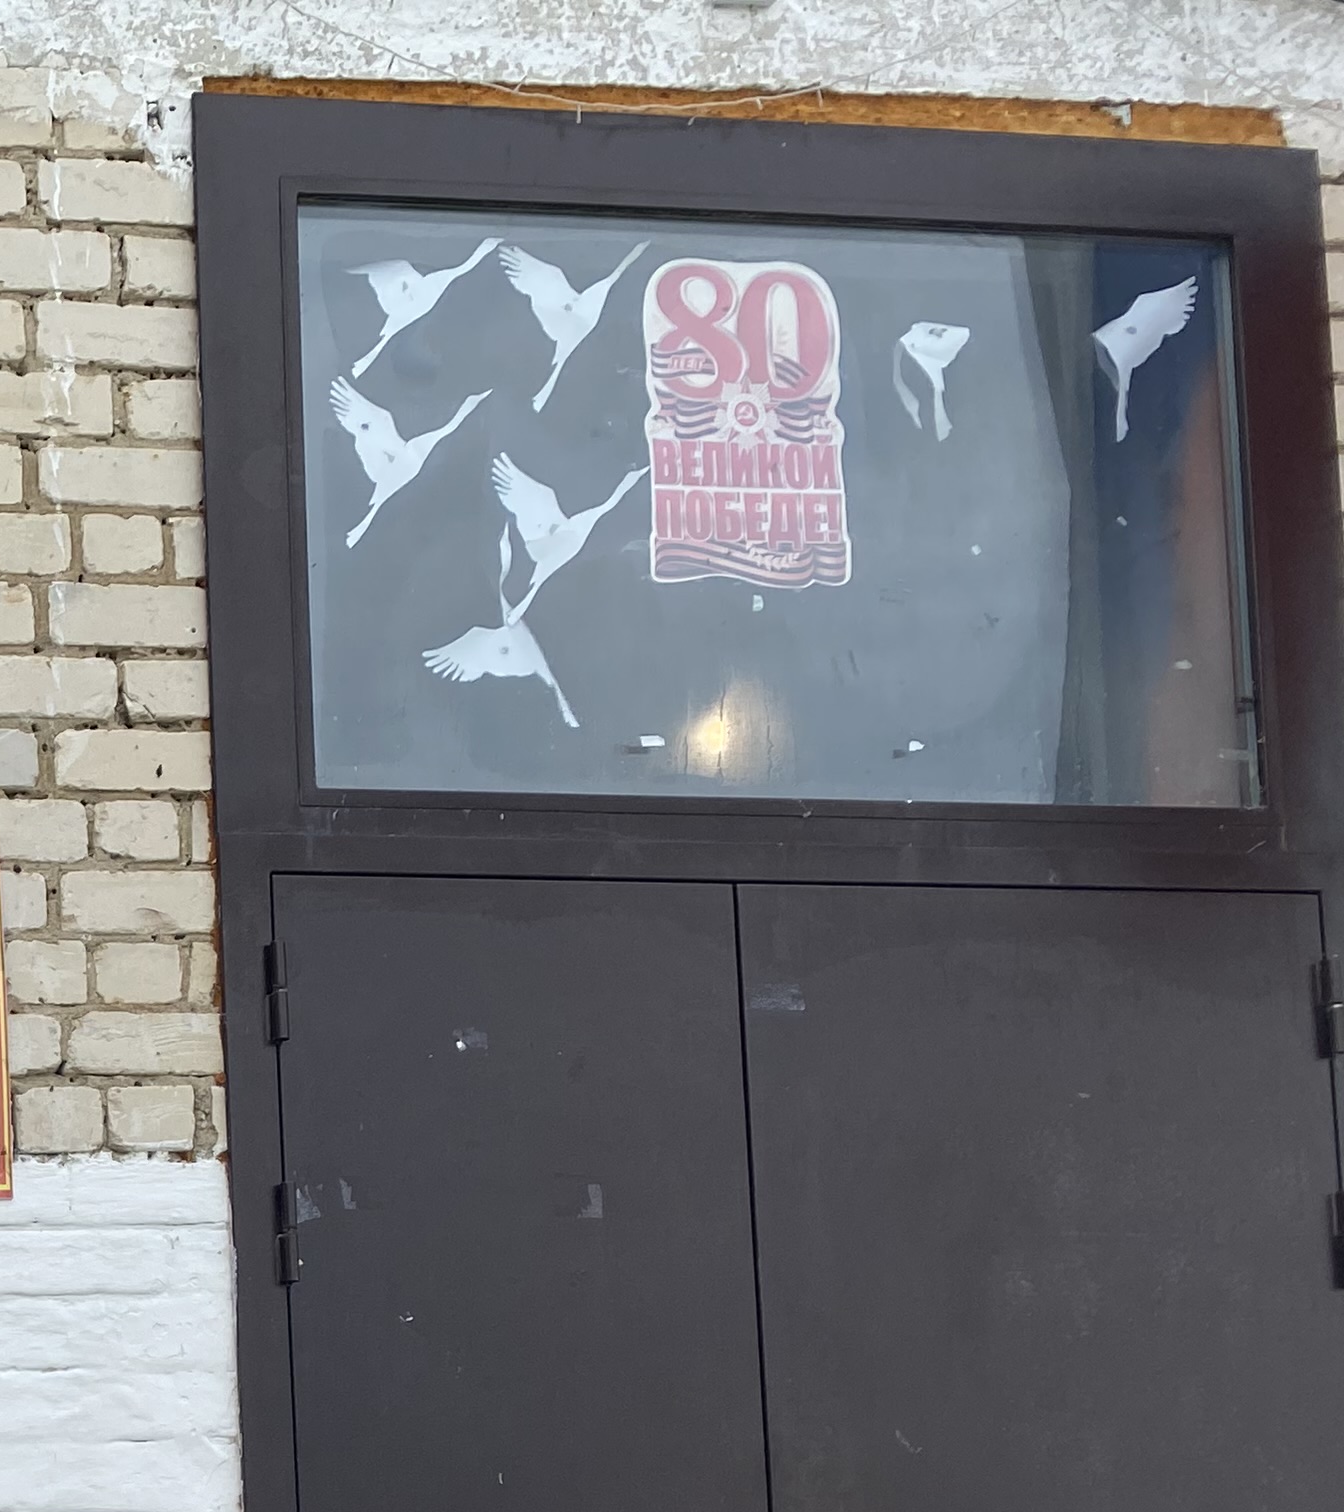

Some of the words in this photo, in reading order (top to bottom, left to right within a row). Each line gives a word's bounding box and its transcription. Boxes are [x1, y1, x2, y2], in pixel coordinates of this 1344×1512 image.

[655, 263, 833, 400] 80
[652, 435, 839, 490] ВЕЛИКОЙ
[654, 490, 843, 550] ПОБЕДЕ!
